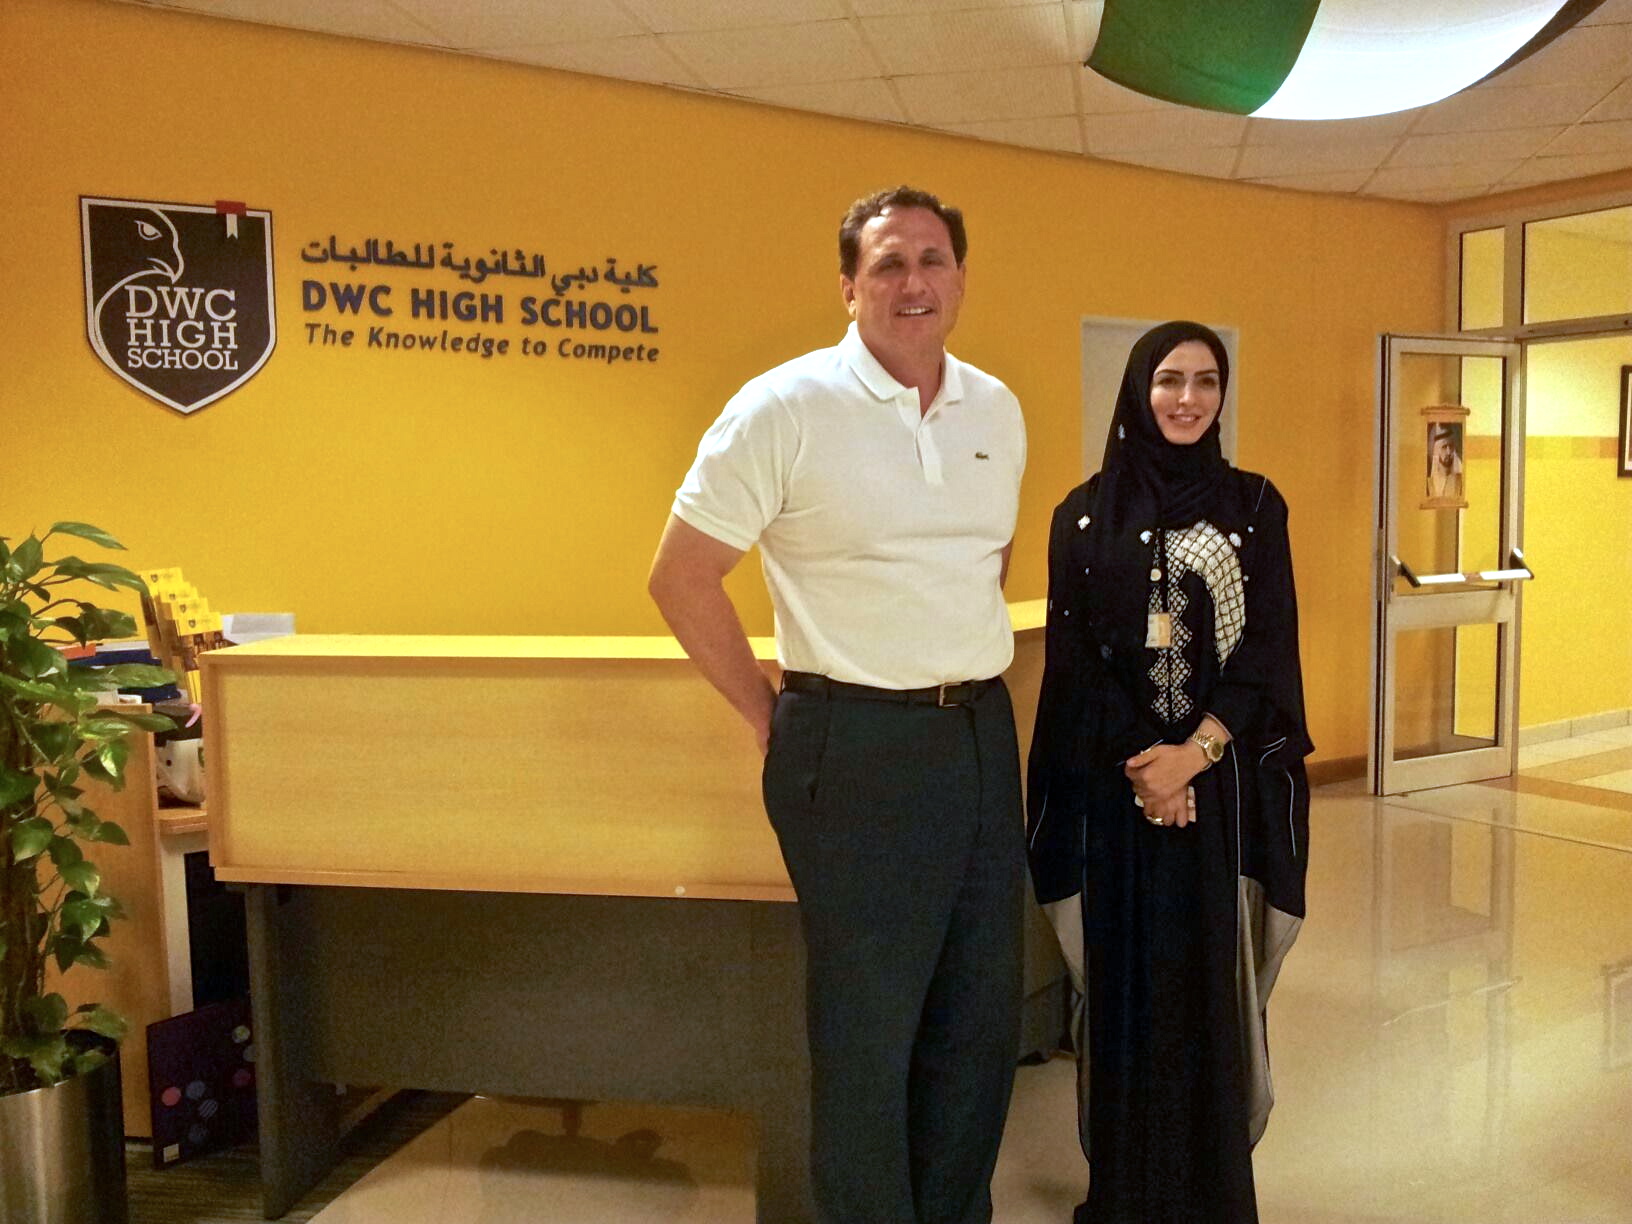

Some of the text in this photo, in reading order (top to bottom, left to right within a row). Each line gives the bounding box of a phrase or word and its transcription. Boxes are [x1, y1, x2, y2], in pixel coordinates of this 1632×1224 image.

[301, 235, 659, 297] كلية دبي الثانوية للطالبات
[124, 285, 237, 321] DWC
[302, 280, 659, 333] DWC HIGH SCHOOL
[126, 318, 238, 349] HIGH
[305, 323, 660, 364] The Knowledge to Compete
[127, 348, 239, 370] SCHOOL
